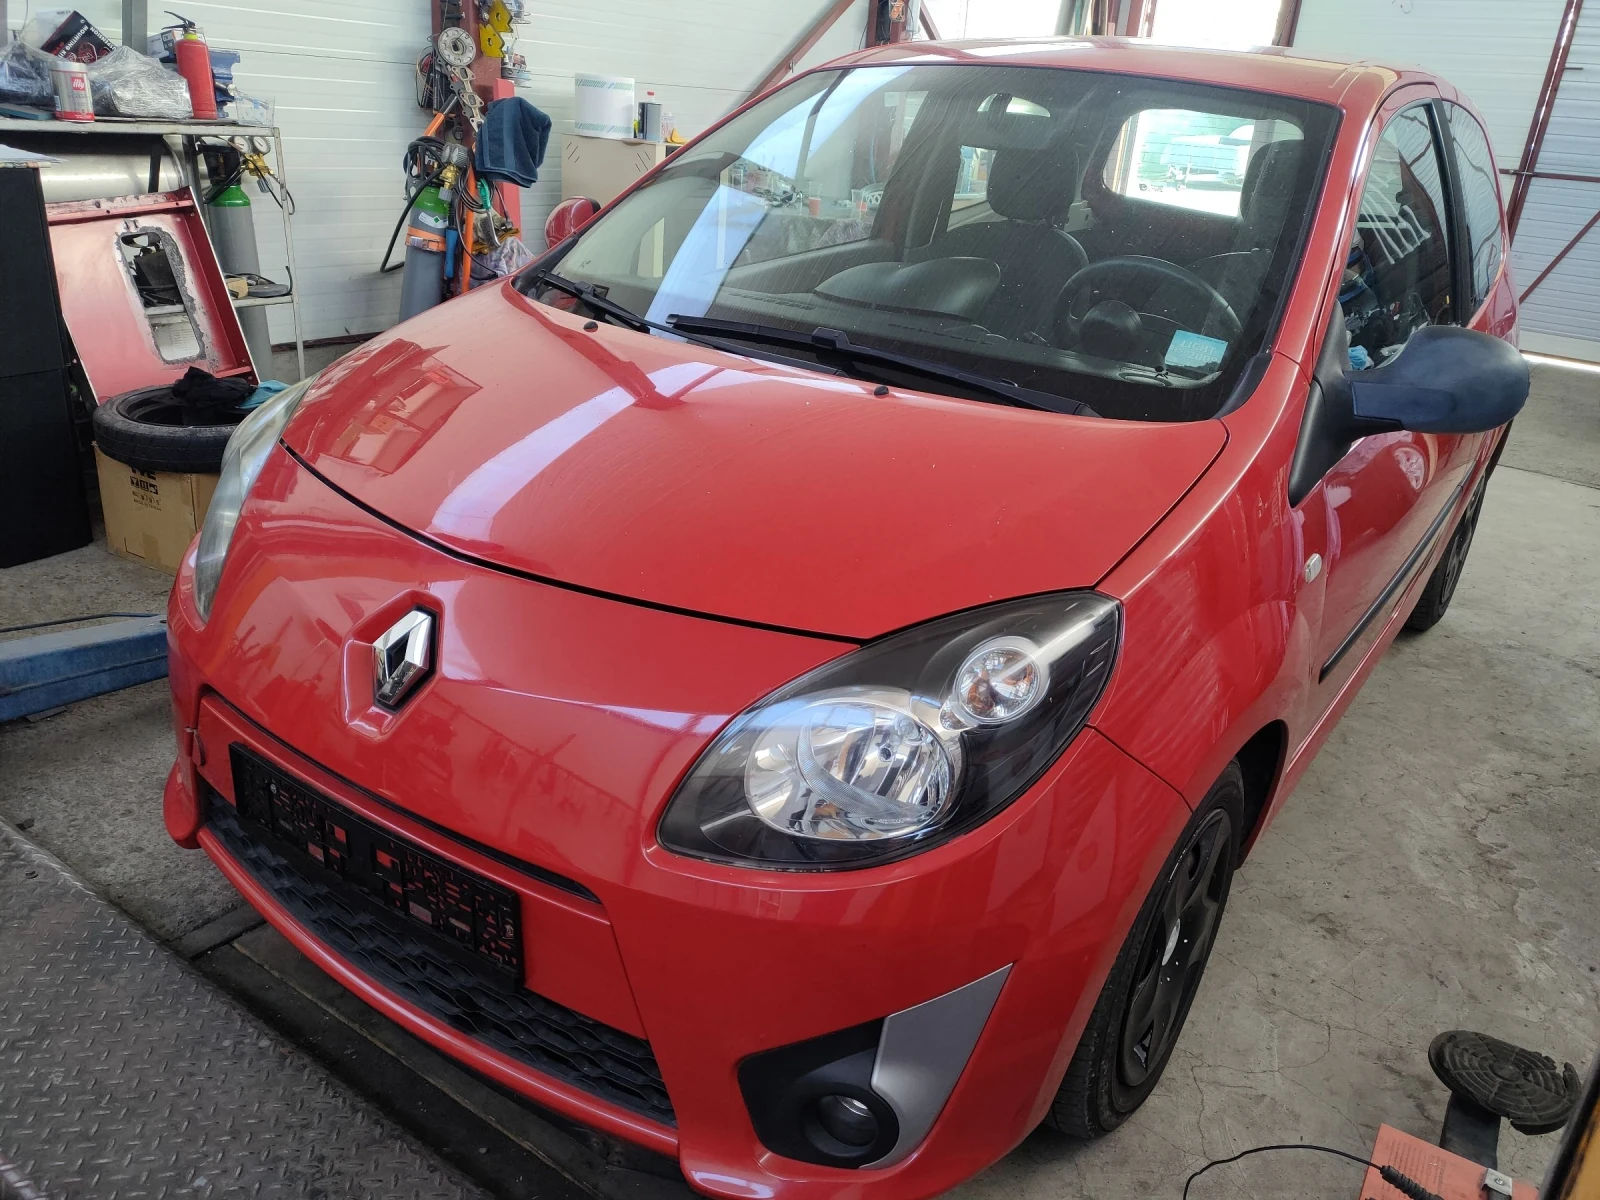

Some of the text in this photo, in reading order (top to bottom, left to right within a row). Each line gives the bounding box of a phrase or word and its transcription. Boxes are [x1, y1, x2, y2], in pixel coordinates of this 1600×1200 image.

[65, 24, 89, 51] MOUNTING
[89, 26, 118, 51] USPENSION
[72, 78, 85, 90] illy
